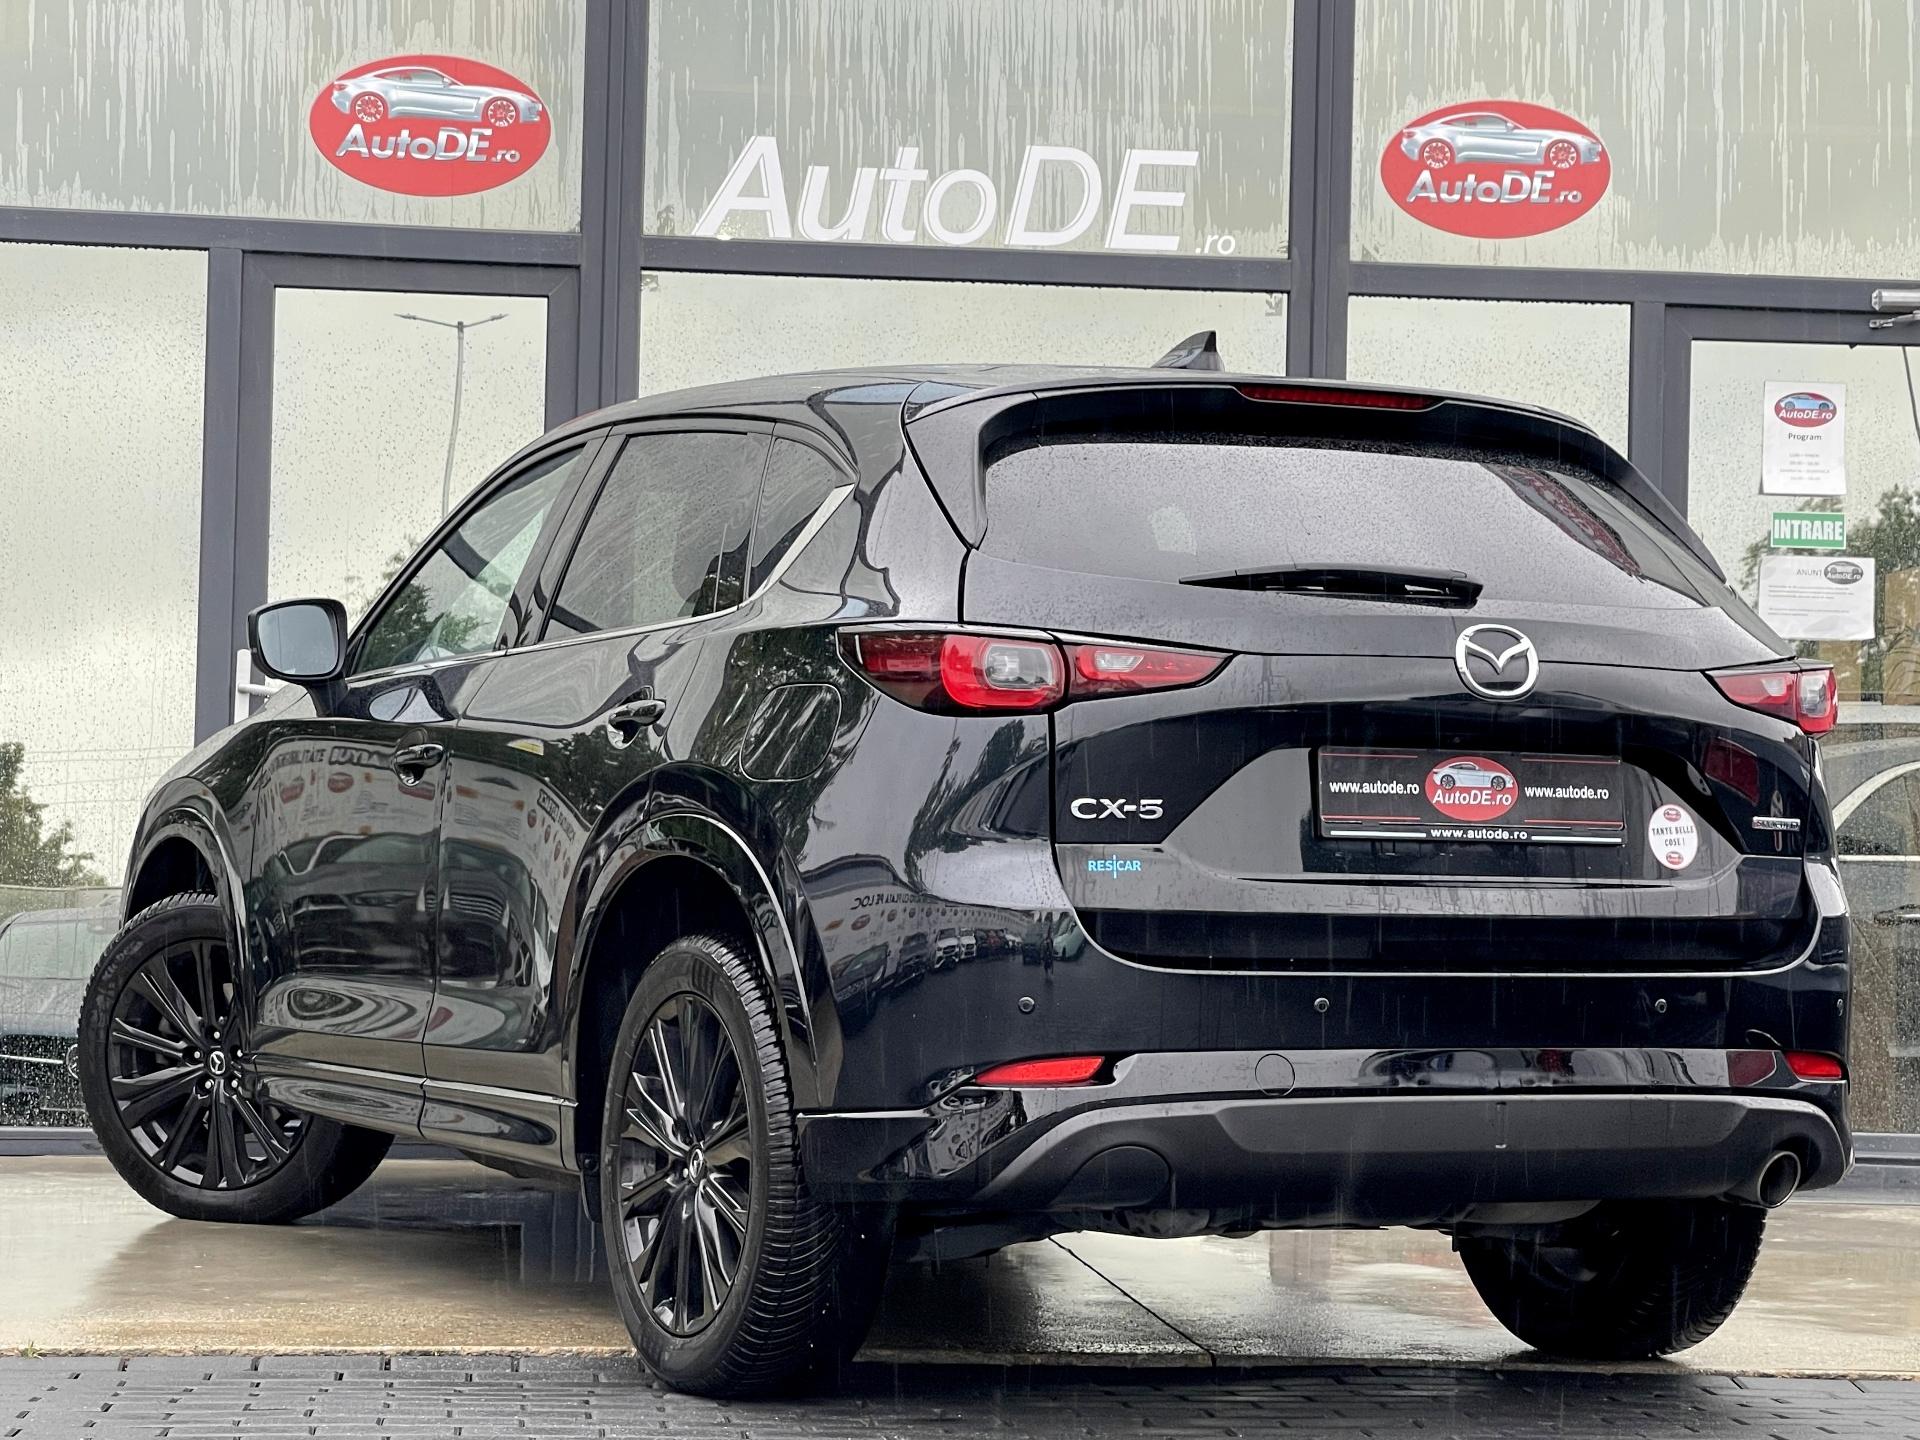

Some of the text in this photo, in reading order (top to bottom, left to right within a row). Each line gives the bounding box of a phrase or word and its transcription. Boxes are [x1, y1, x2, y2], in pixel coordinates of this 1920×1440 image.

[1779, 409, 1833, 420] AutoDE.ro
[1788, 432, 1822, 442] Program
[1773, 519, 1844, 541] INTRARE
[1329, 780, 1420, 795] www.autode.ro
[1524, 784, 1610, 799] www.autode.ro
[1432, 789, 1512, 806] AutoDE.ro
[1070, 798, 1164, 819] CX-5
[1430, 828, 1528, 840] www.autode.ro
